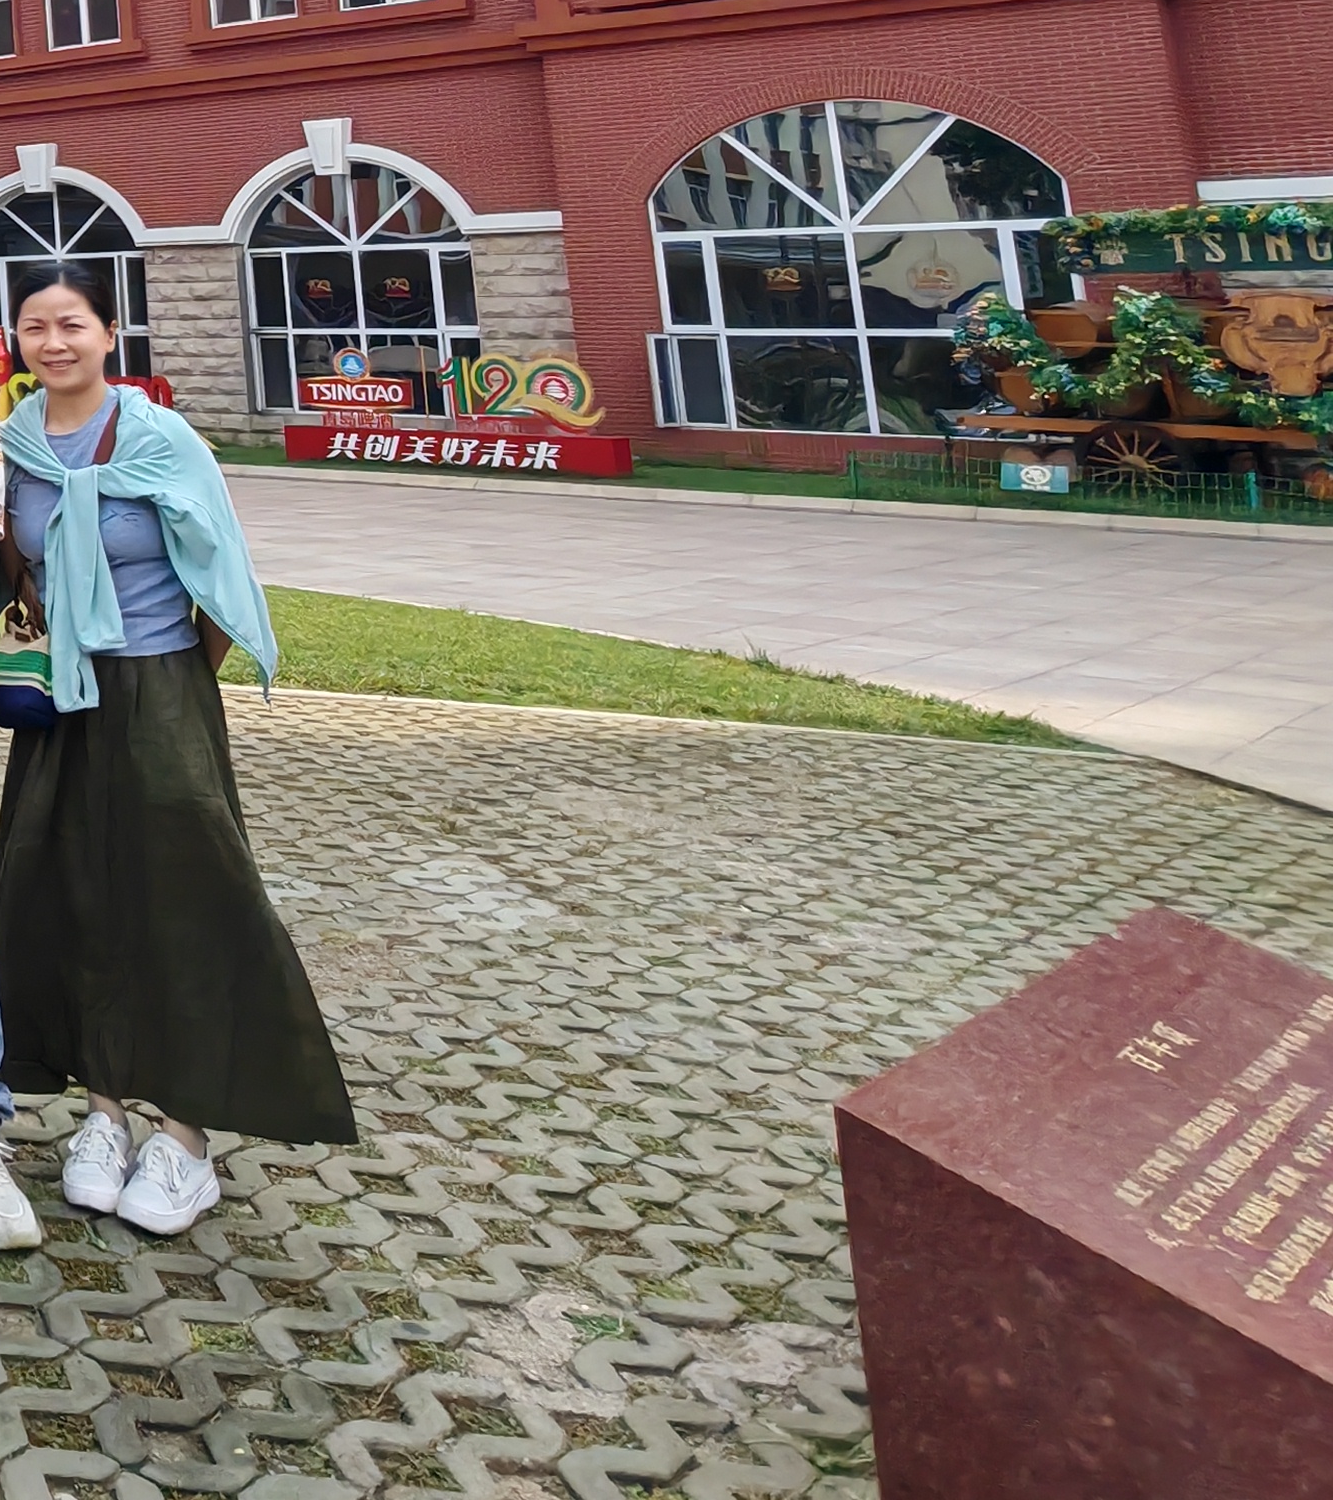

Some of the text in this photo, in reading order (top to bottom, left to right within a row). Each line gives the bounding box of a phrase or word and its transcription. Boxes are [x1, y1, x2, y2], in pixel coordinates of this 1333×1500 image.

[1163, 231, 1333, 265] TSING
[306, 383, 404, 403] TSINGTAO
[436, 352, 606, 427] 120
[325, 431, 563, 471] 共创美好未来
